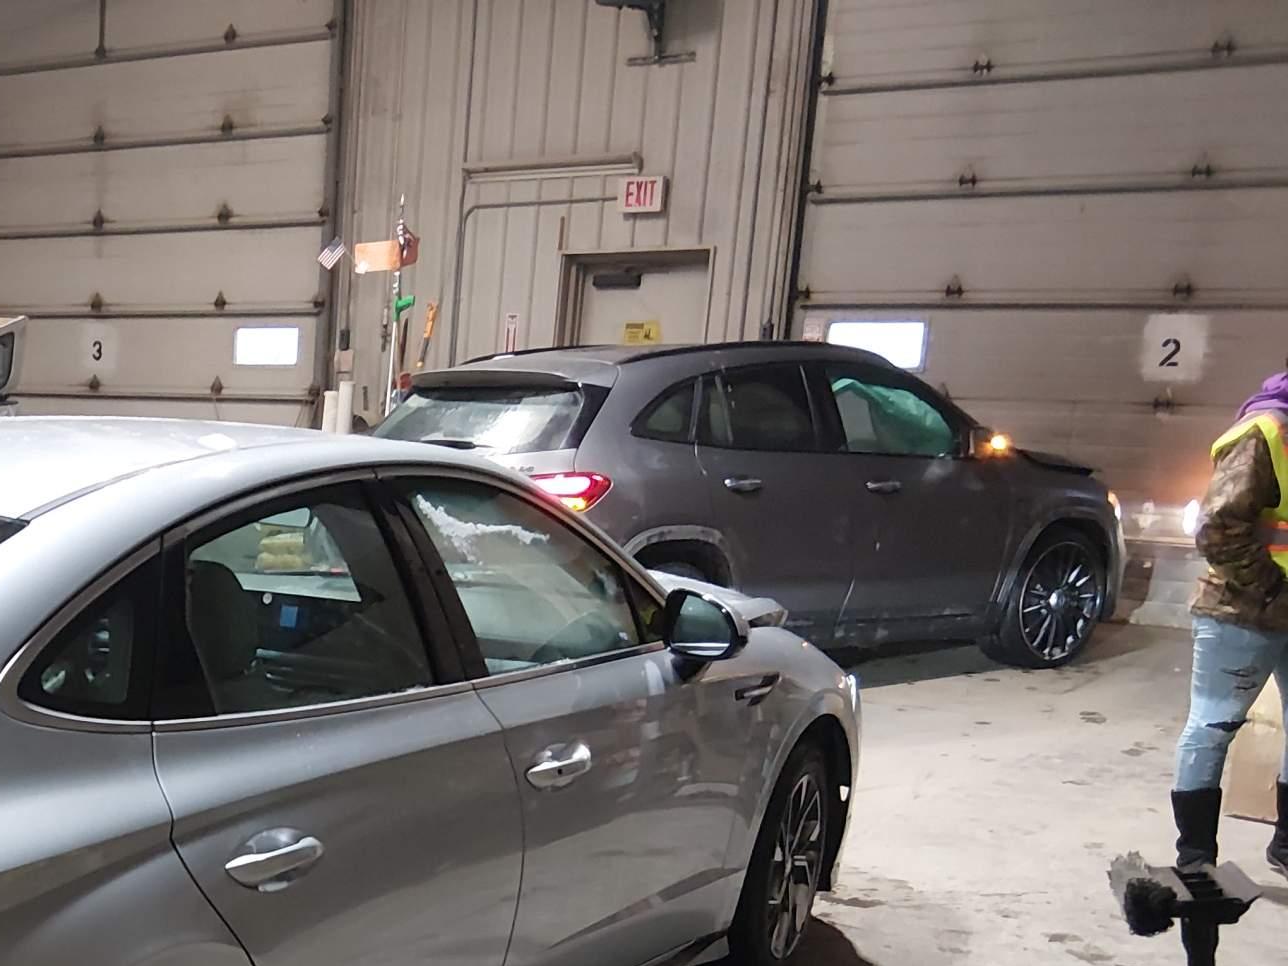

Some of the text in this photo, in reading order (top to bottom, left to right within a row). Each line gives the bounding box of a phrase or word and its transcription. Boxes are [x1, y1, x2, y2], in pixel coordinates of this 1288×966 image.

[624, 180, 657, 208] EXIT
[92, 340, 102, 361] 3
[1158, 338, 1181, 367] 2
